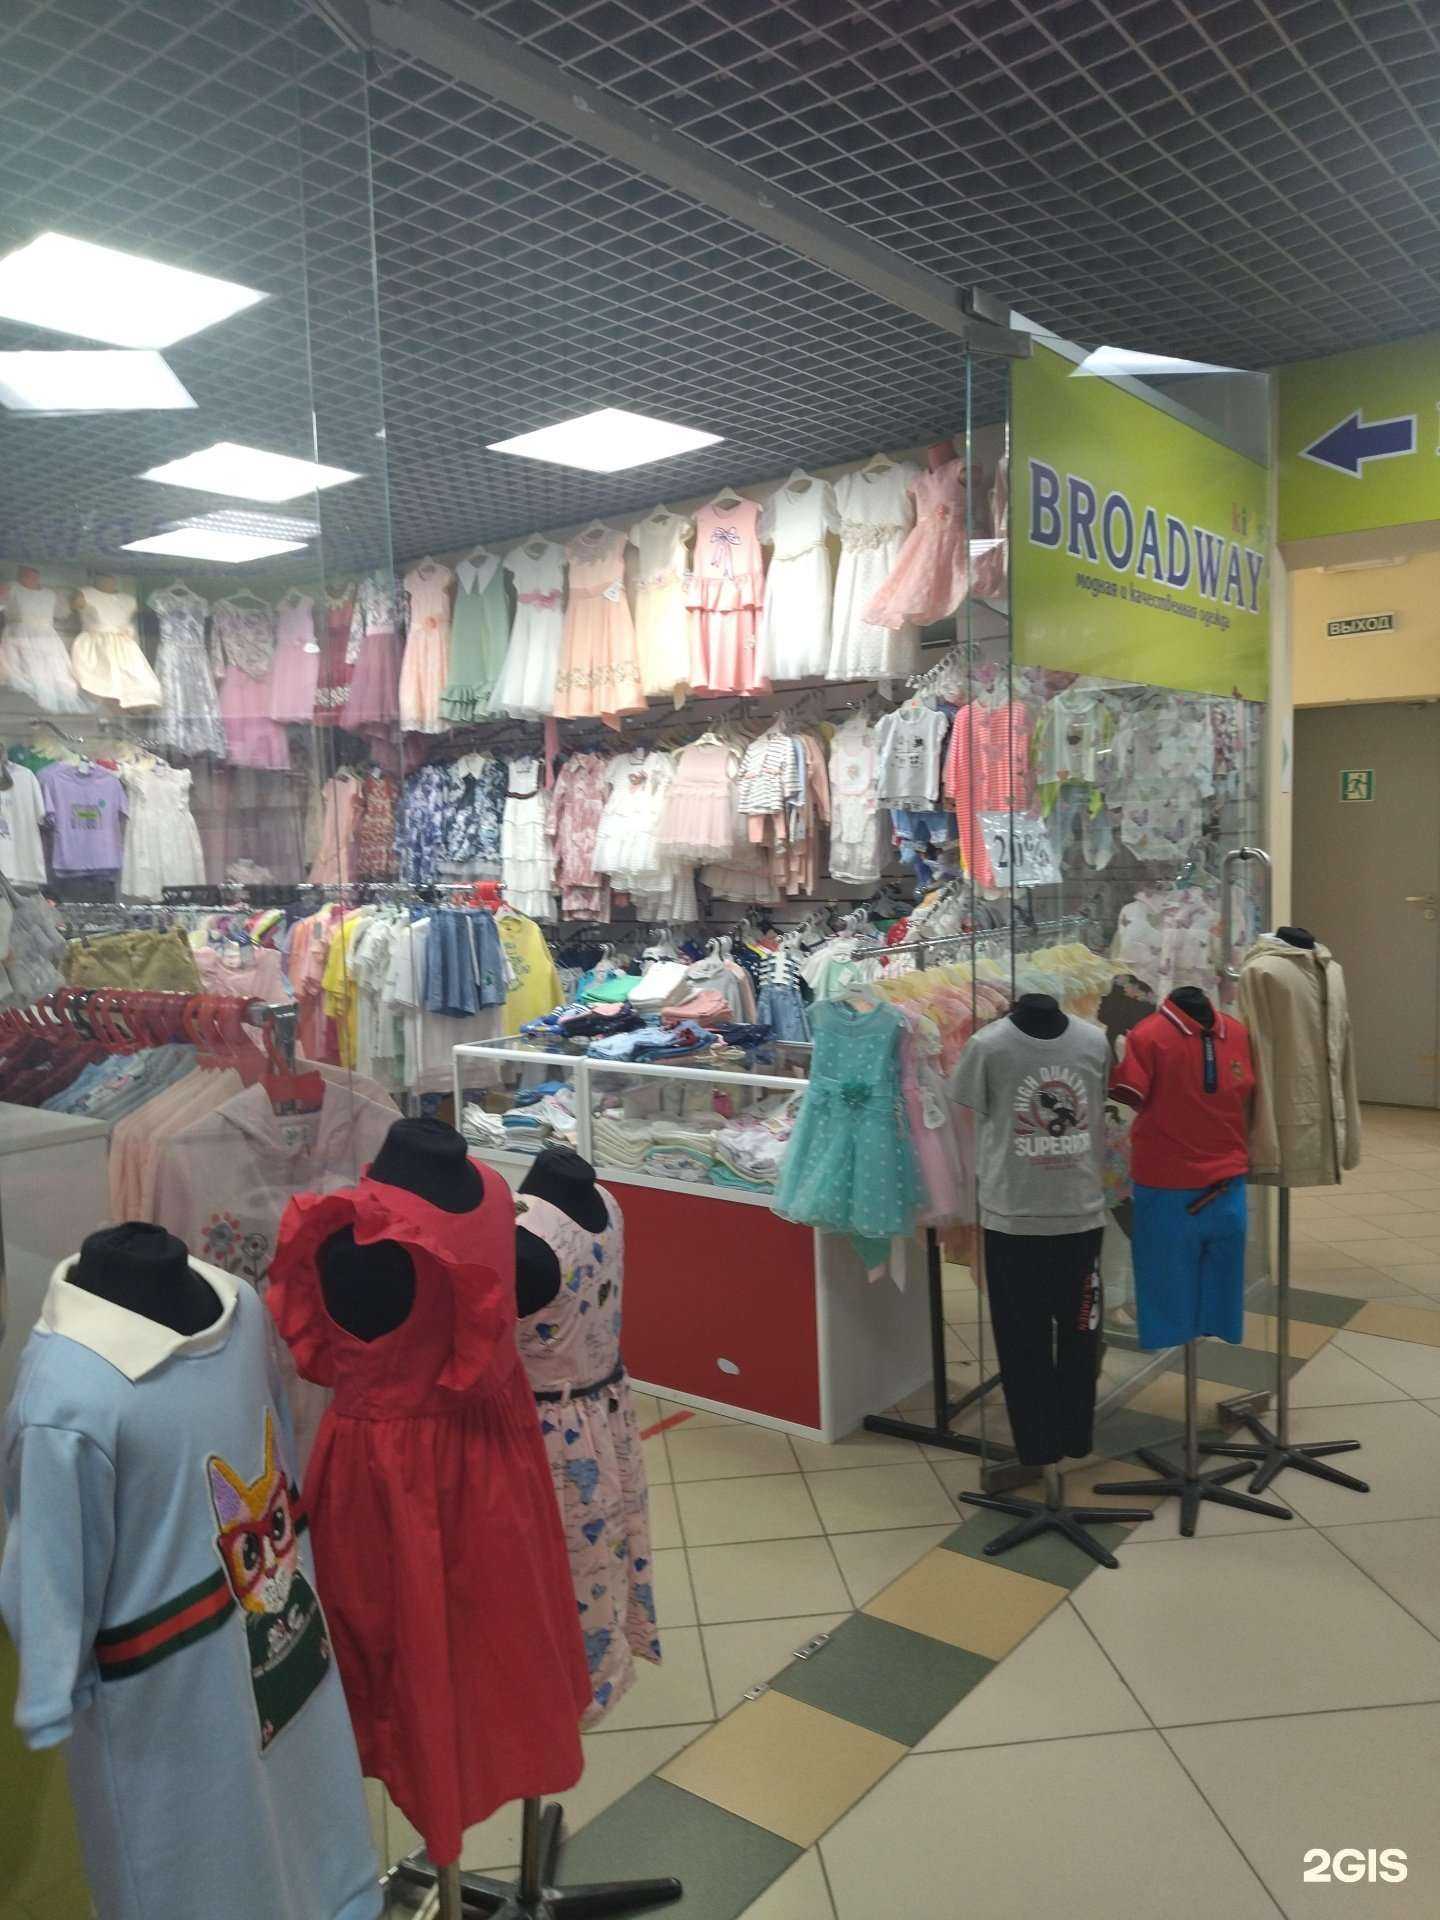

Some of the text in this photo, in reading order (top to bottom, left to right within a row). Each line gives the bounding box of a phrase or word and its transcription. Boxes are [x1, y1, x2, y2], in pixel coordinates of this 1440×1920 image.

[1029, 456, 1264, 614] BROADWAY
[1329, 616, 1390, 635] ВЫХОД
[1013, 1075, 1040, 1112] HIGH
